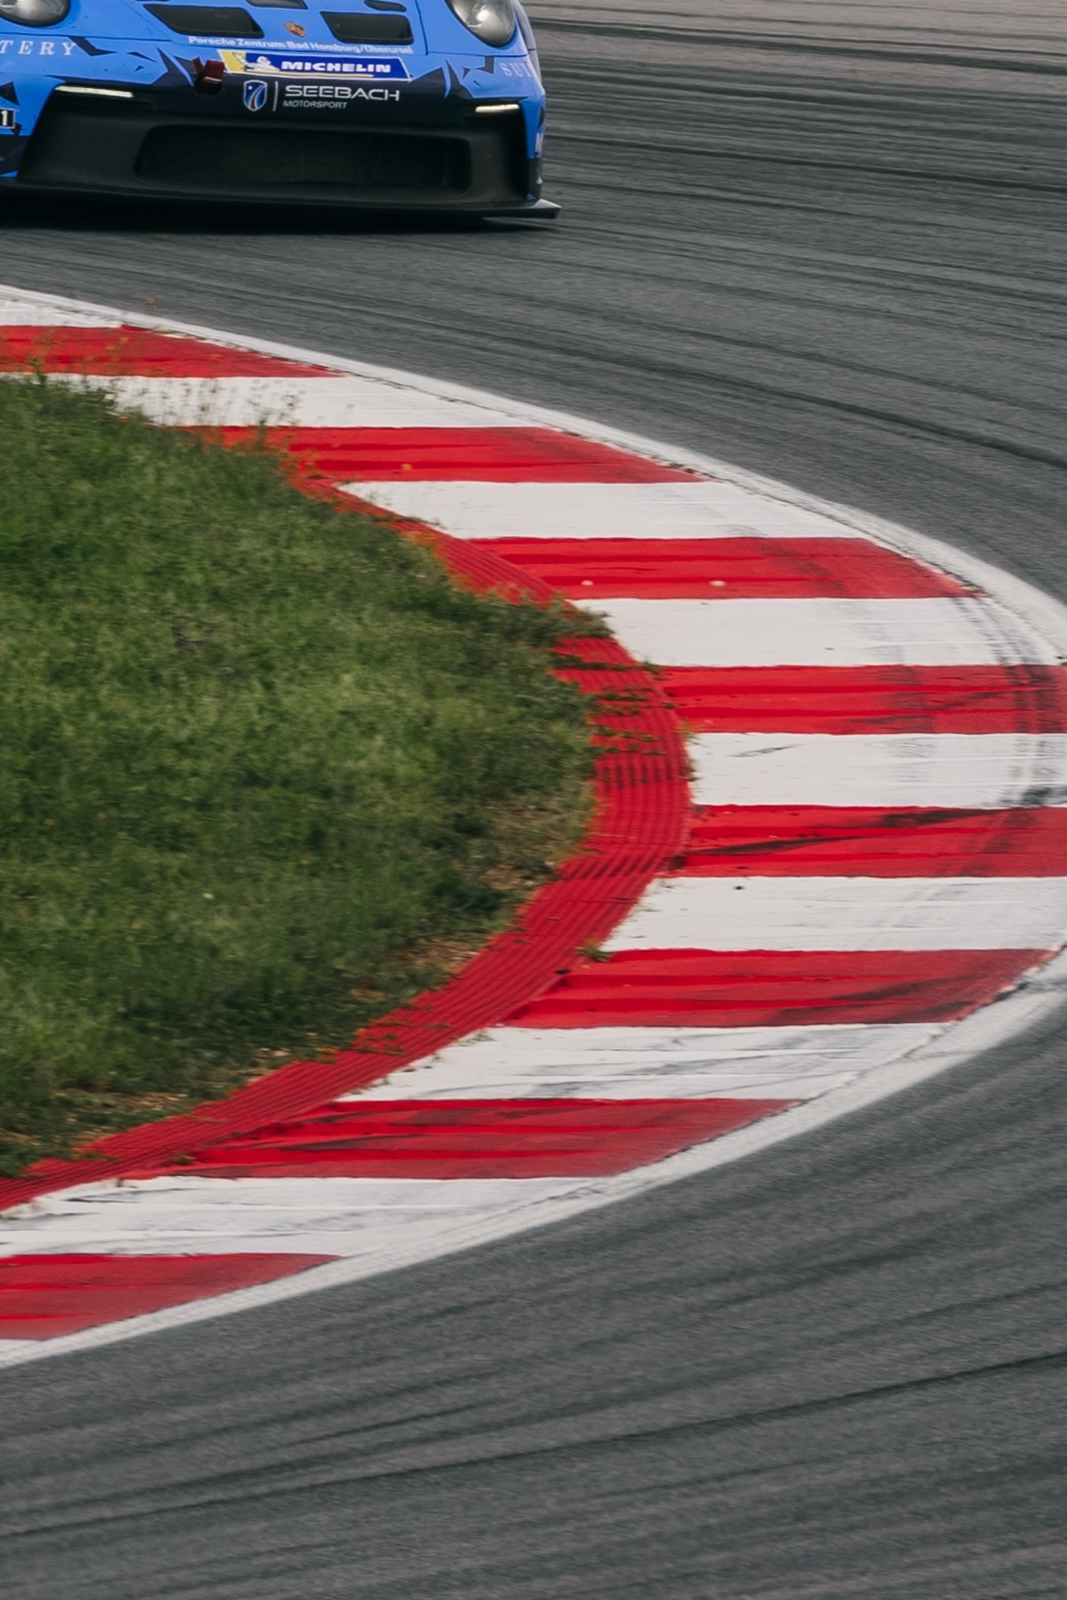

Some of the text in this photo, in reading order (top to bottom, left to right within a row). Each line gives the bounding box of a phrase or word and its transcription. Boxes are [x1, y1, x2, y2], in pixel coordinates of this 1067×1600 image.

[188, 36, 236, 46] Porsche
[236, 38, 286, 49] Zentrum
[286, 41, 309, 51] Bad
[281, 61, 391, 73] MICHELIN
[285, 85, 400, 101] SEEBACH
[283, 100, 348, 109] MOTORSPORT
